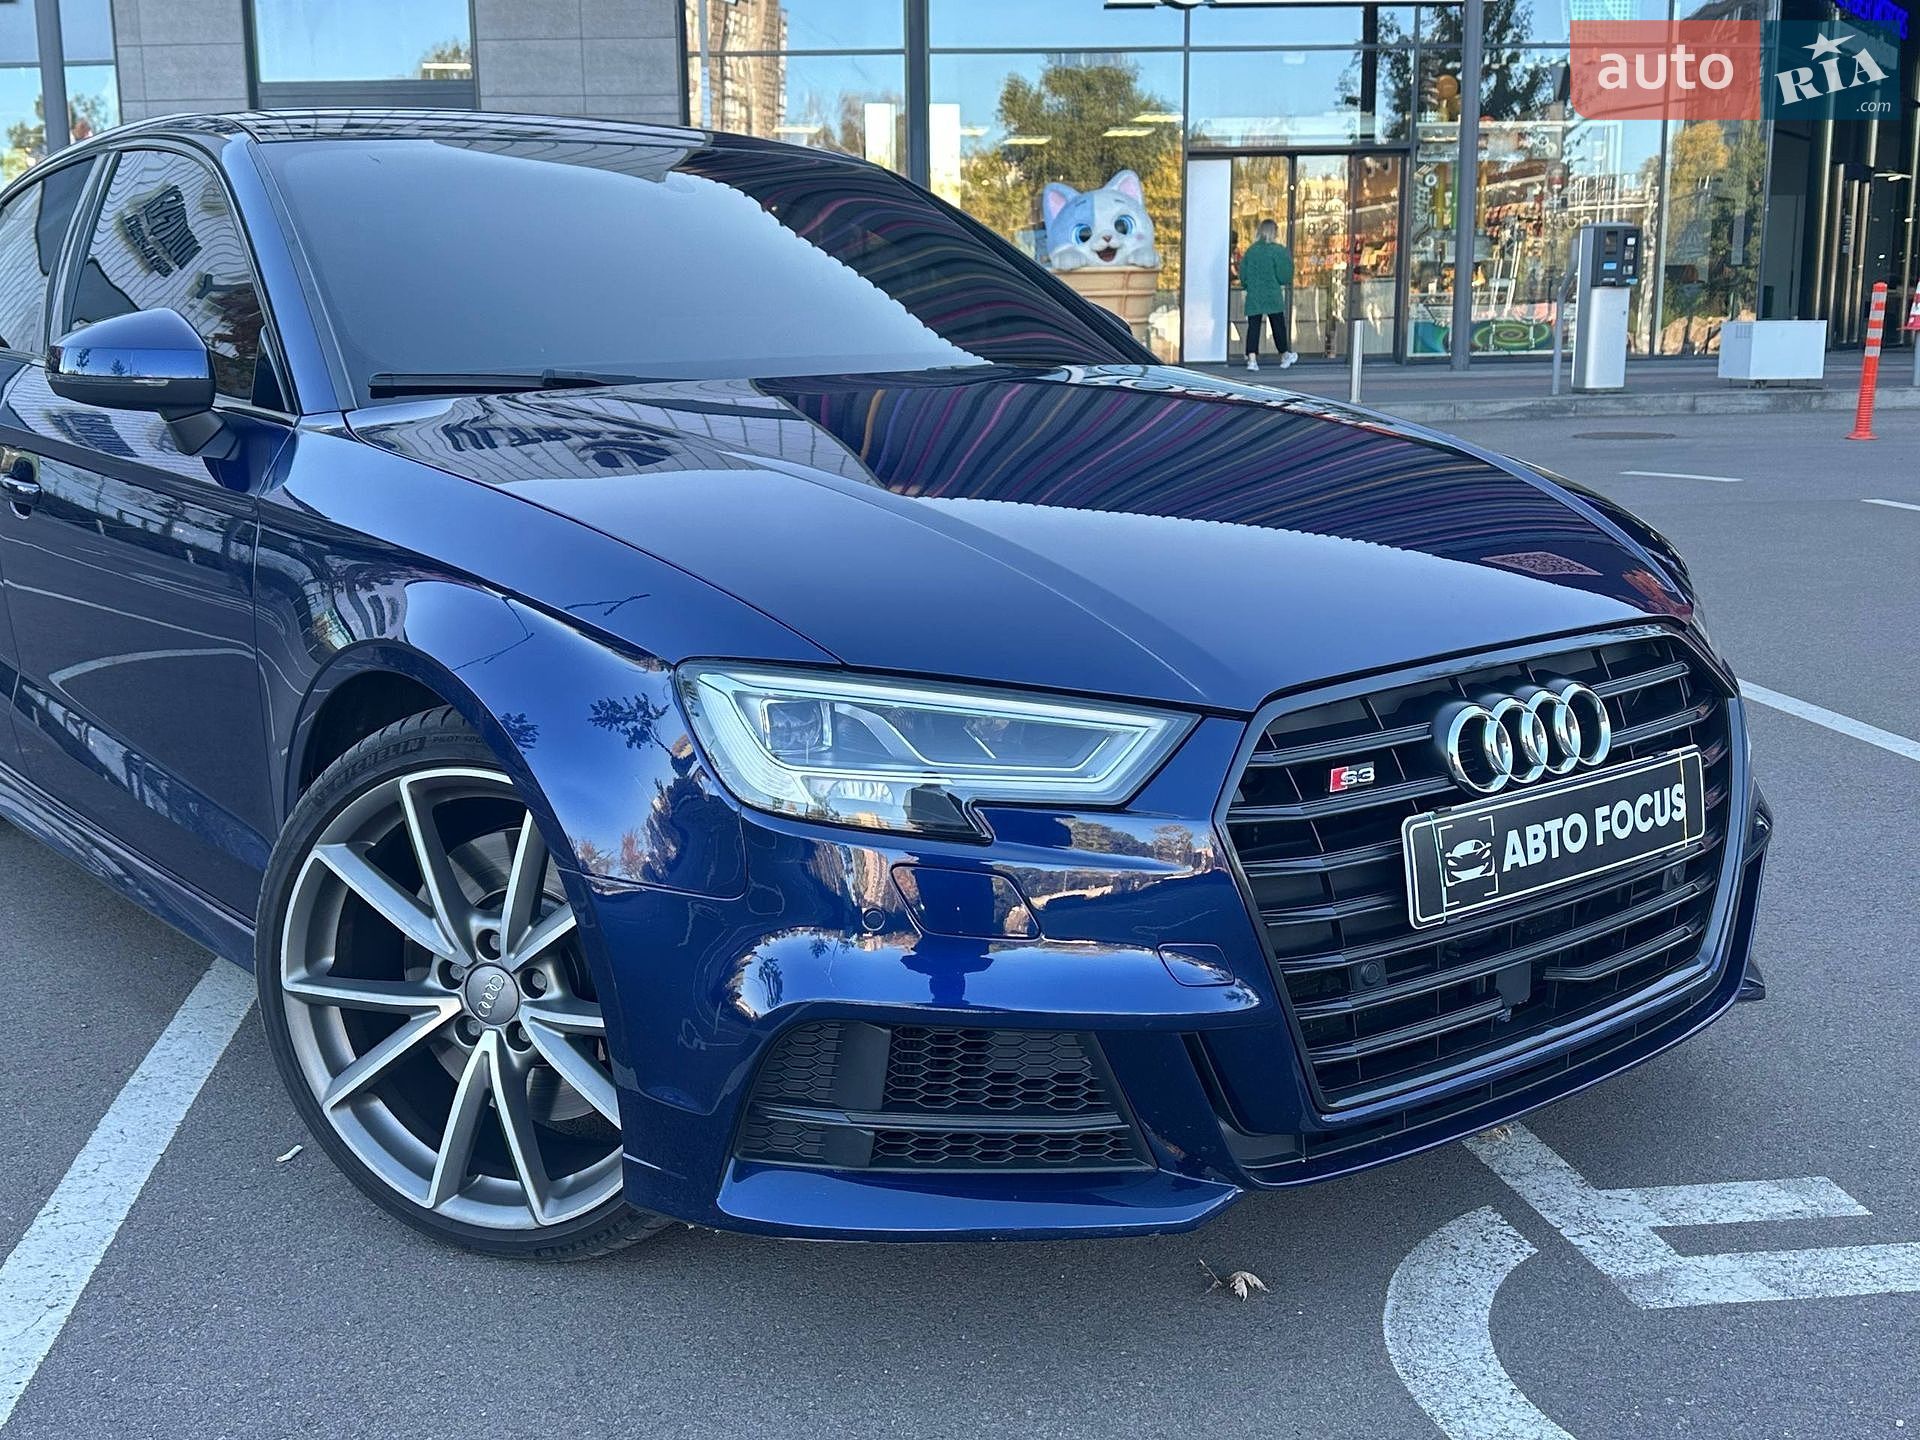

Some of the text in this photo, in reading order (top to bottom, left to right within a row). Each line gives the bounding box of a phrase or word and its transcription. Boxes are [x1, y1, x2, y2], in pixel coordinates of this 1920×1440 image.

[1339, 766, 1375, 786] S3
[1502, 783, 1686, 873] АВТО FOCUS
